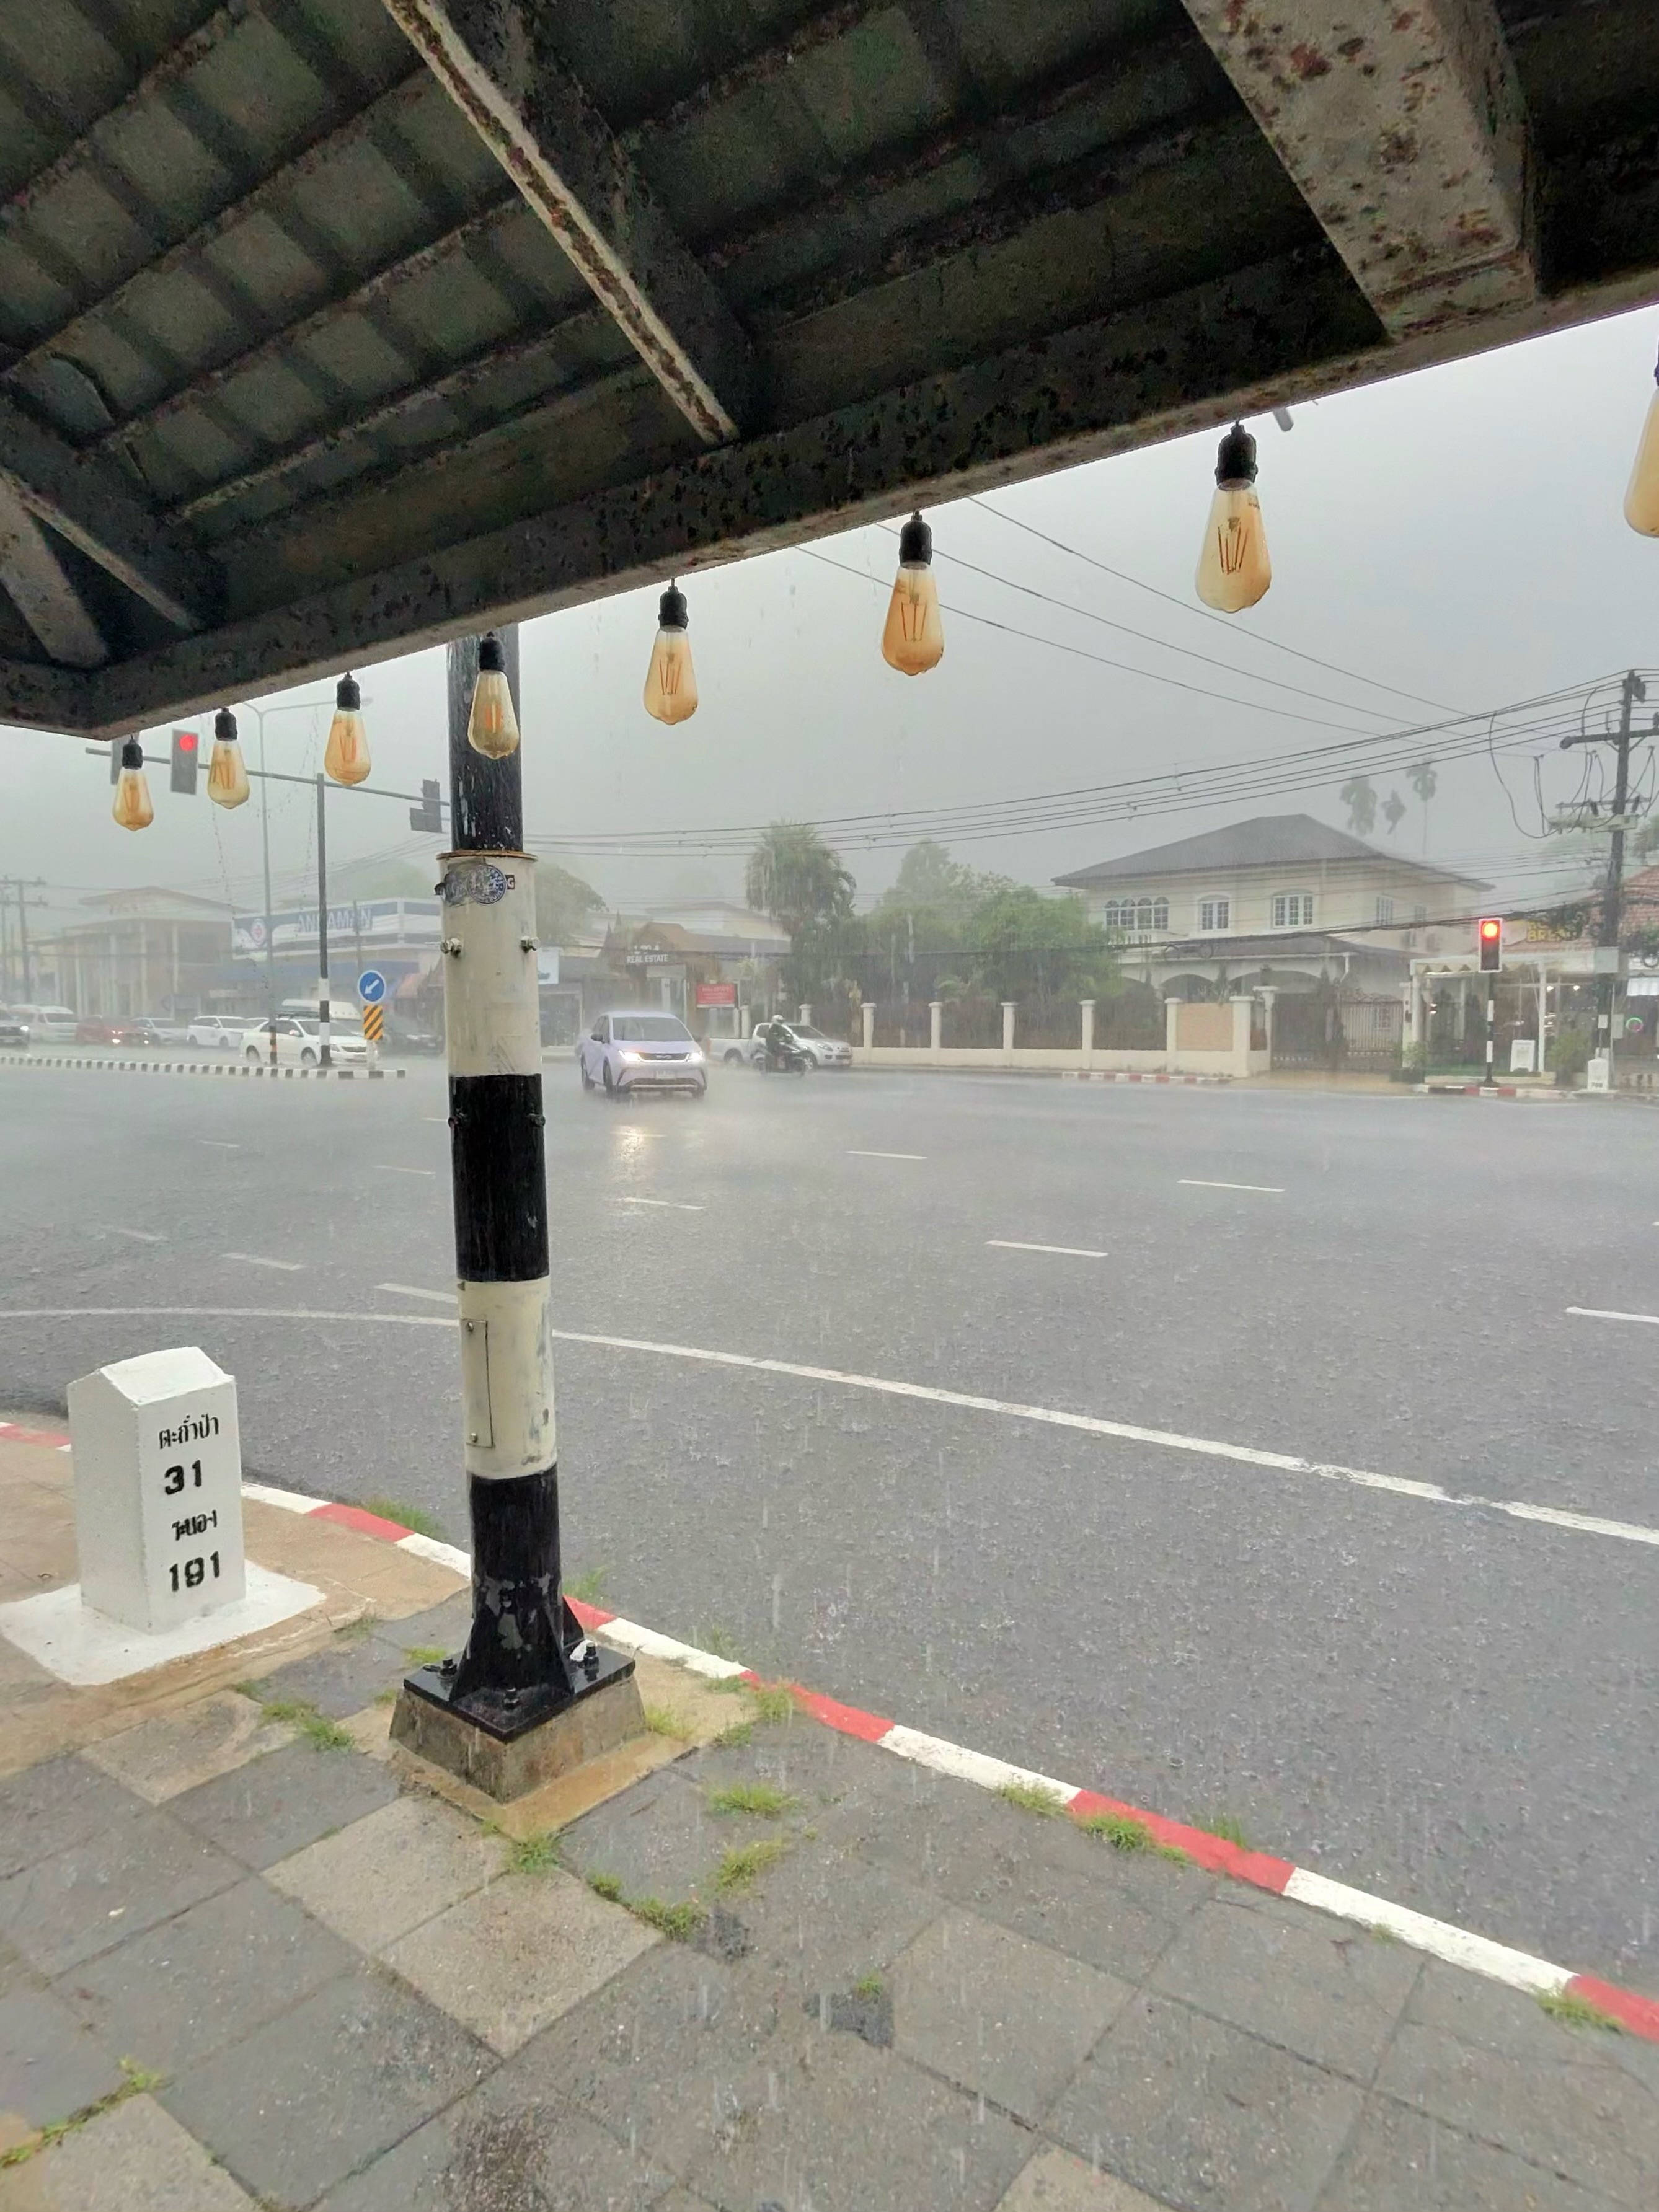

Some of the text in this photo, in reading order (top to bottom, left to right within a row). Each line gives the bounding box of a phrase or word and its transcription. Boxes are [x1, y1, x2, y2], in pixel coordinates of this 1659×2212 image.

[627, 954, 669, 963] REAL ESTATE
[164, 1458, 203, 1495] 31
[171, 1509, 218, 1541] ระนอง
[169, 1550, 221, 1592] 191
